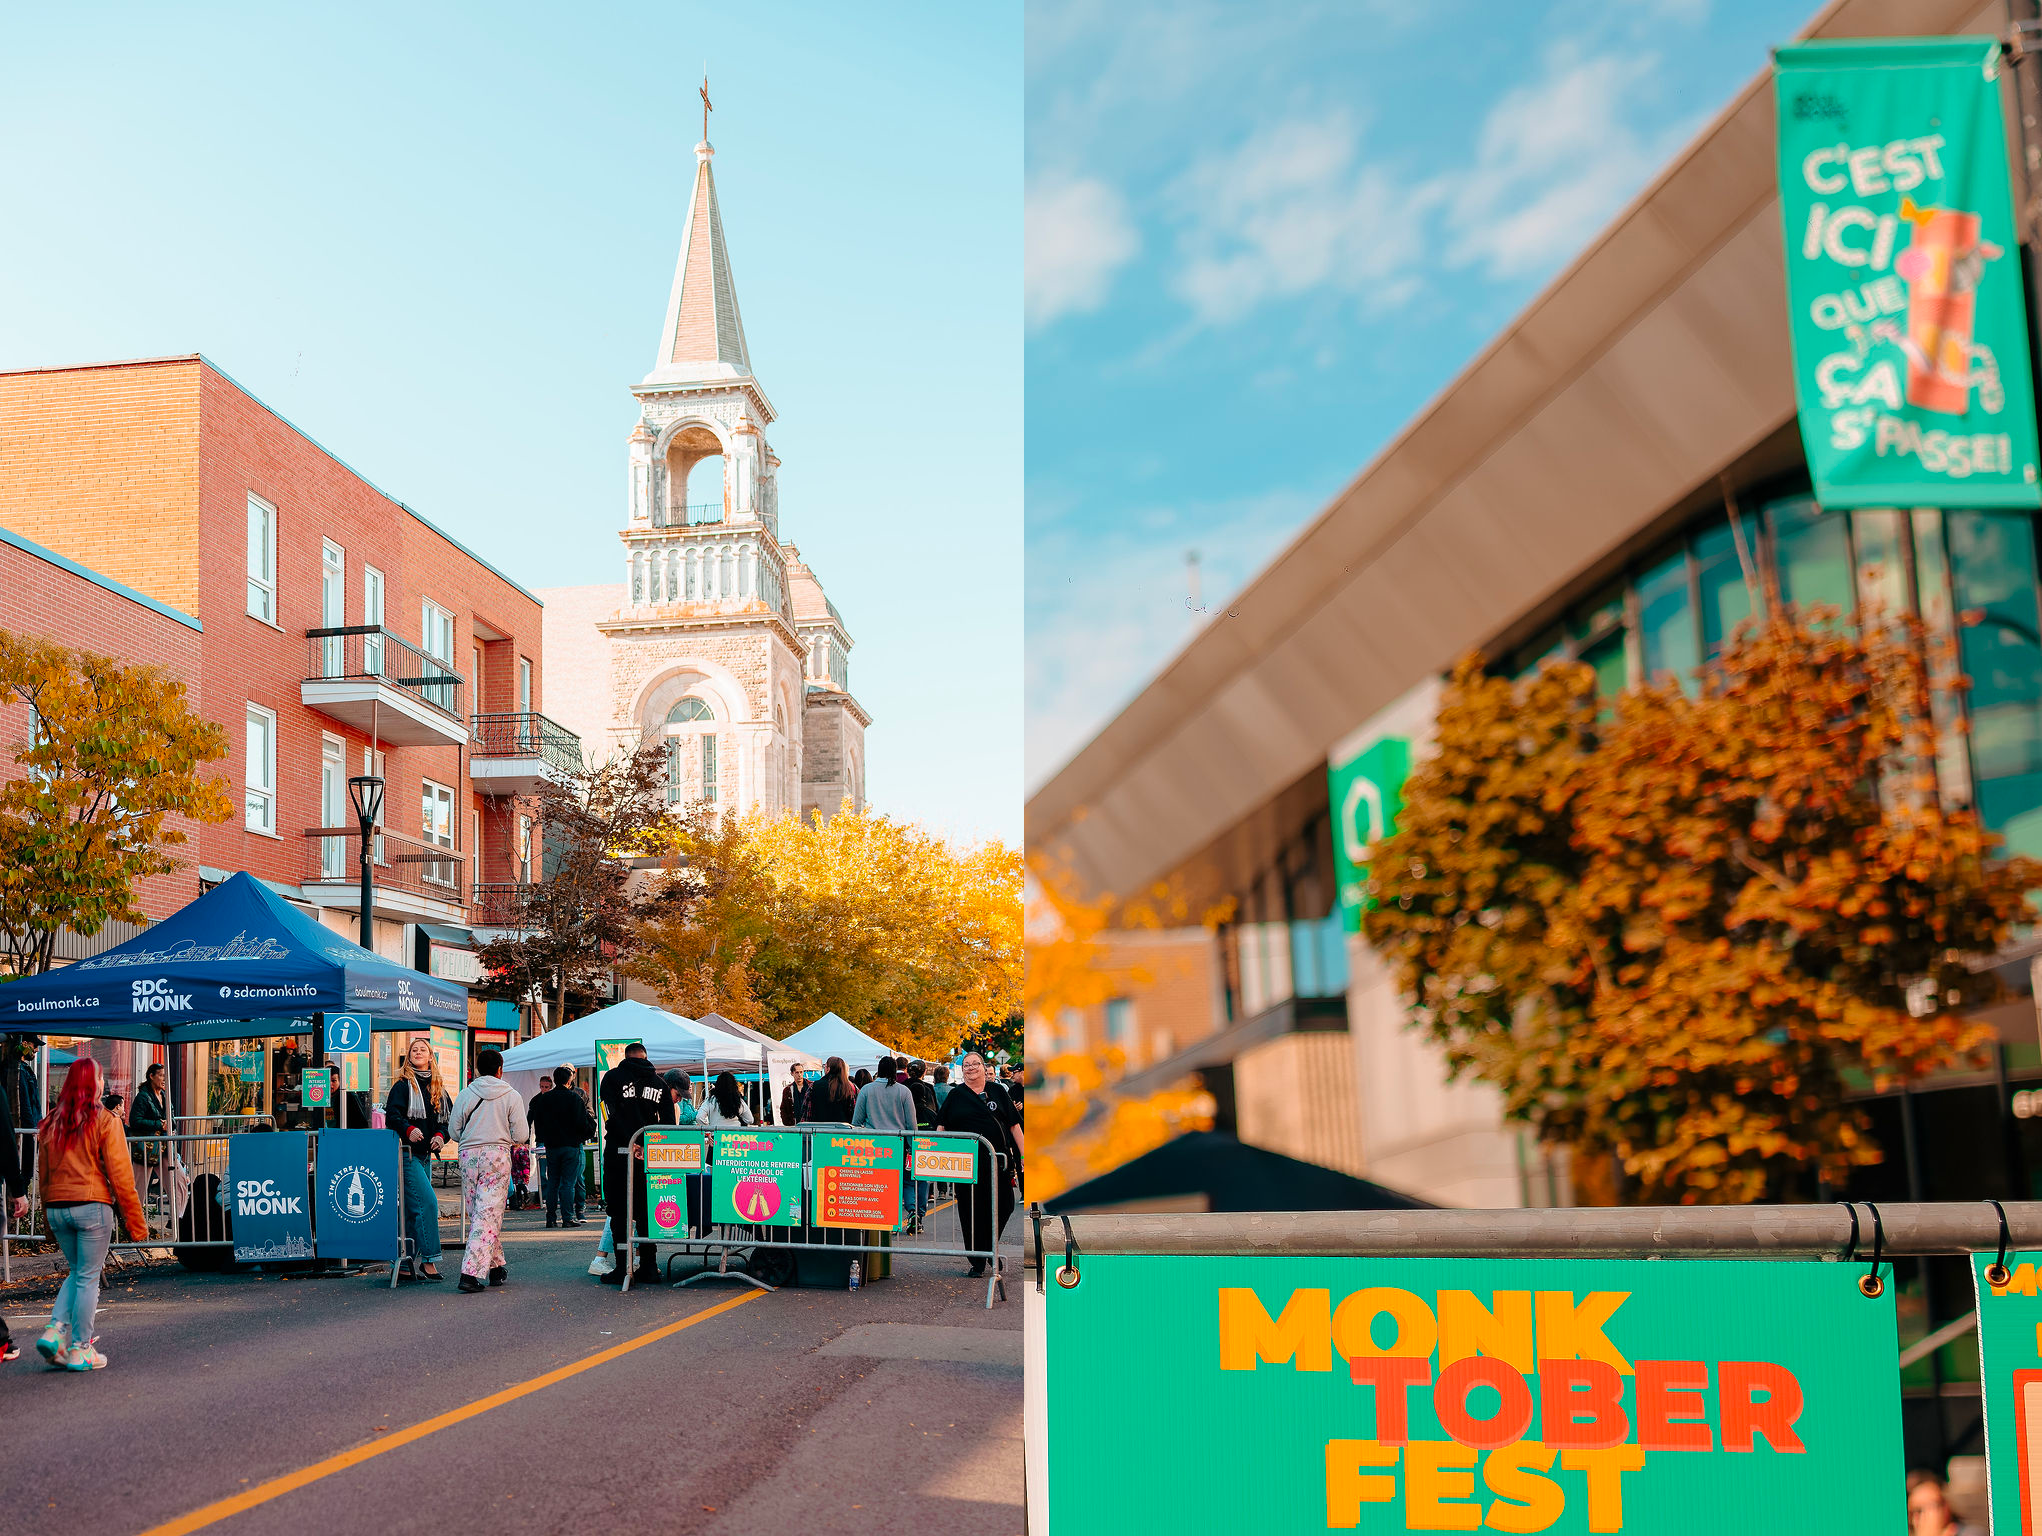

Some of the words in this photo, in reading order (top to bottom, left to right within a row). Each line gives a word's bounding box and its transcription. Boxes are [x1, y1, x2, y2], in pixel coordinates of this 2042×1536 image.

[1803, 134, 1944, 197] C'EST
[1803, 203, 1897, 270] ICI
[1811, 276, 1906, 329] QUE
[1816, 353, 1902, 411] ÇA
[131, 978, 174, 996] SDC.
[233, 984, 317, 998] sdcmonkinfo
[355, 986, 388, 999] boulmonk.ca
[397, 980, 414, 996] SDC.
[17, 996, 100, 1012] boulmonk.ca
[132, 994, 193, 1013] MONK
[398, 996, 422, 1013] MONK
[721, 1133, 759, 1143] MONK
[732, 1140, 774, 1151] TOBER
[831, 1137, 876, 1149] MONK
[648, 1145, 700, 1162] ENTRÉE
[720, 1148, 750, 1157] FEST
[844, 1145, 893, 1158] TOBER
[715, 1159, 760, 1167] INTERDICTION
[841, 1155, 876, 1167] FEST
[917, 1155, 972, 1171] SORTIE
[736, 1174, 778, 1183] L'EXTÉRIEUR
[748, 1168, 774, 1176] ALCOOL
[237, 1179, 281, 1198] SDC.
[328, 1165, 353, 1197] THÉÂTRE
[360, 1165, 384, 1206] PARADOXE
[238, 1196, 303, 1216] MONK
[659, 1195, 677, 1203] AVIS
[1218, 1286, 1636, 1377] MONK
[1350, 1355, 1807, 1454] TOBER
[1325, 1438, 1646, 1535] FEST
